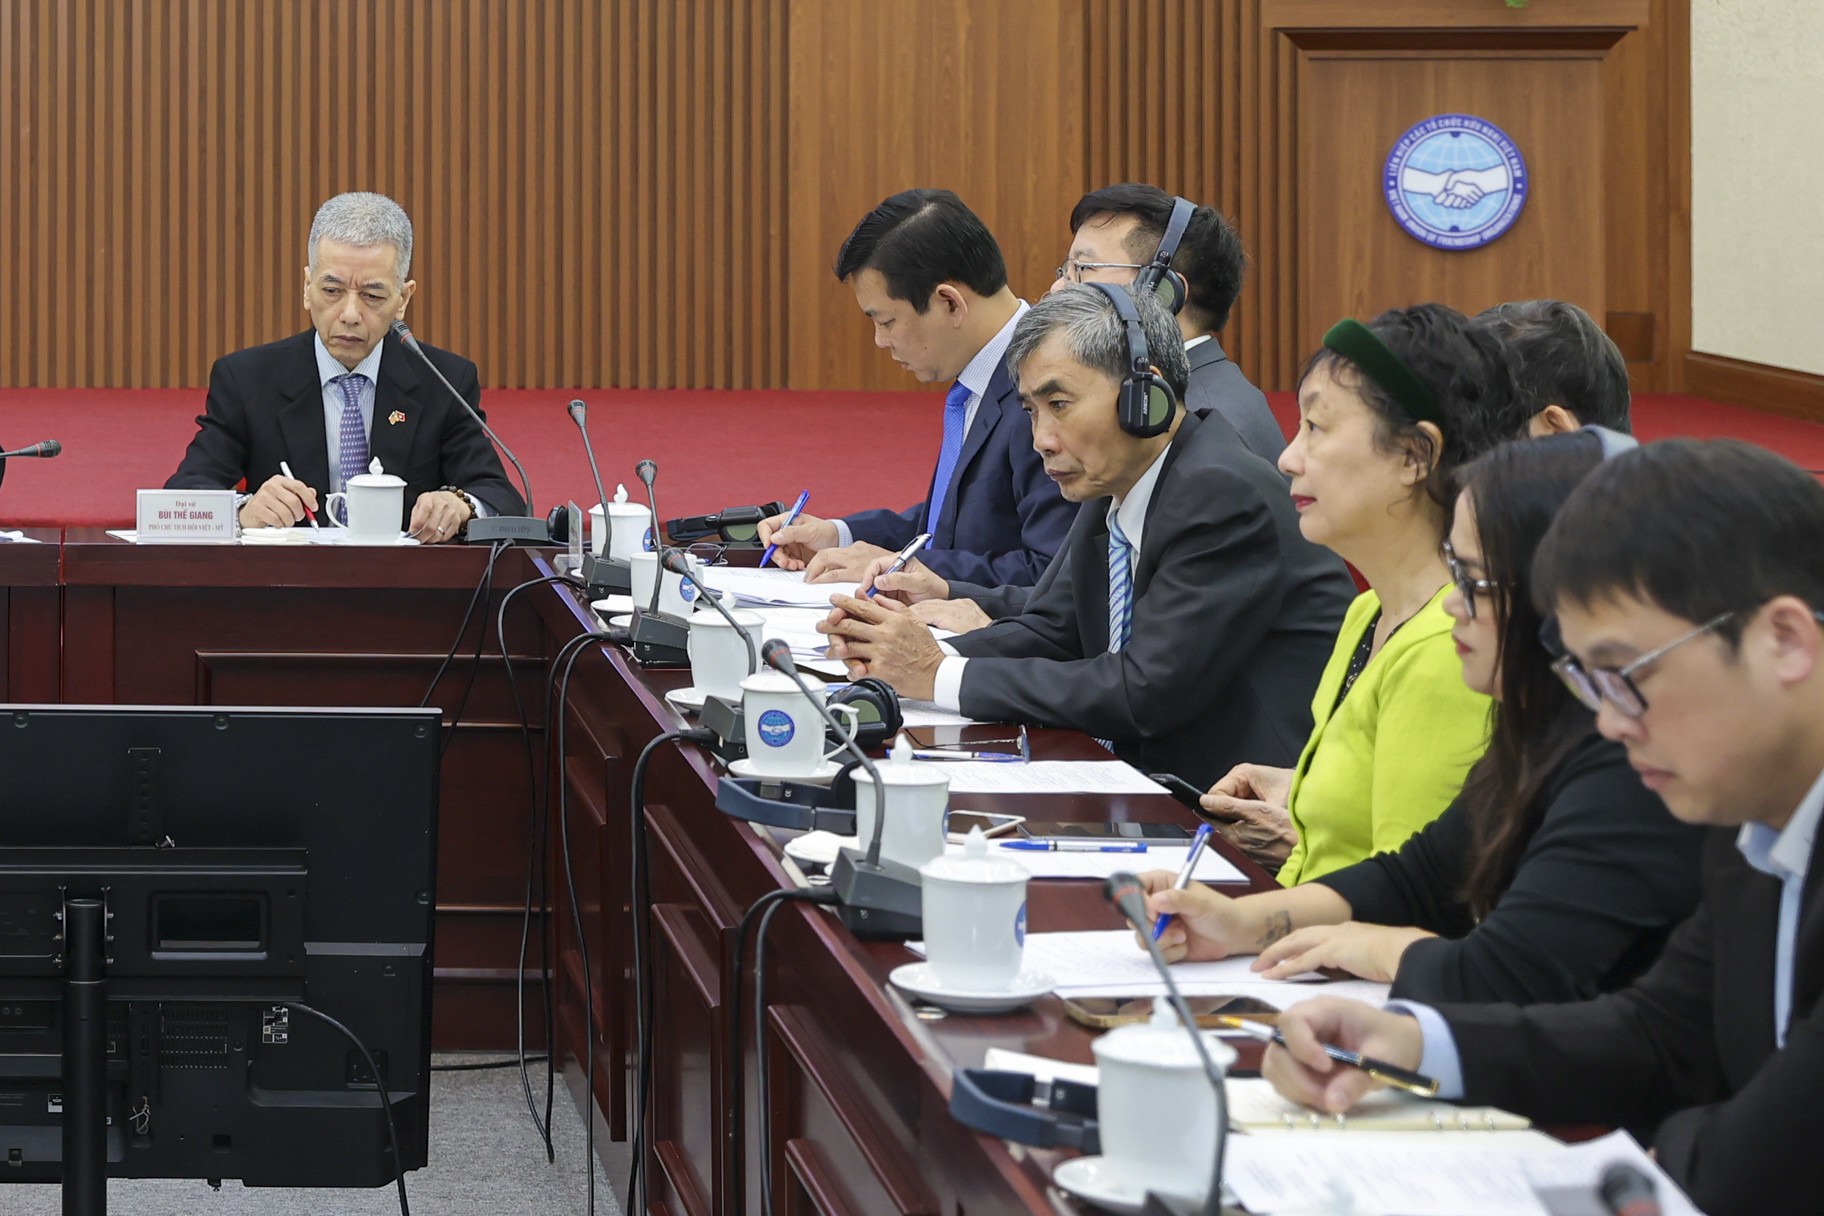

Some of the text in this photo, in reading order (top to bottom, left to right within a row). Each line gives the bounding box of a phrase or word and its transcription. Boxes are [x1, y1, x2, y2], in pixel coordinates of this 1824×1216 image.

[158, 509, 213, 519] BÙI THẾ GIANG
